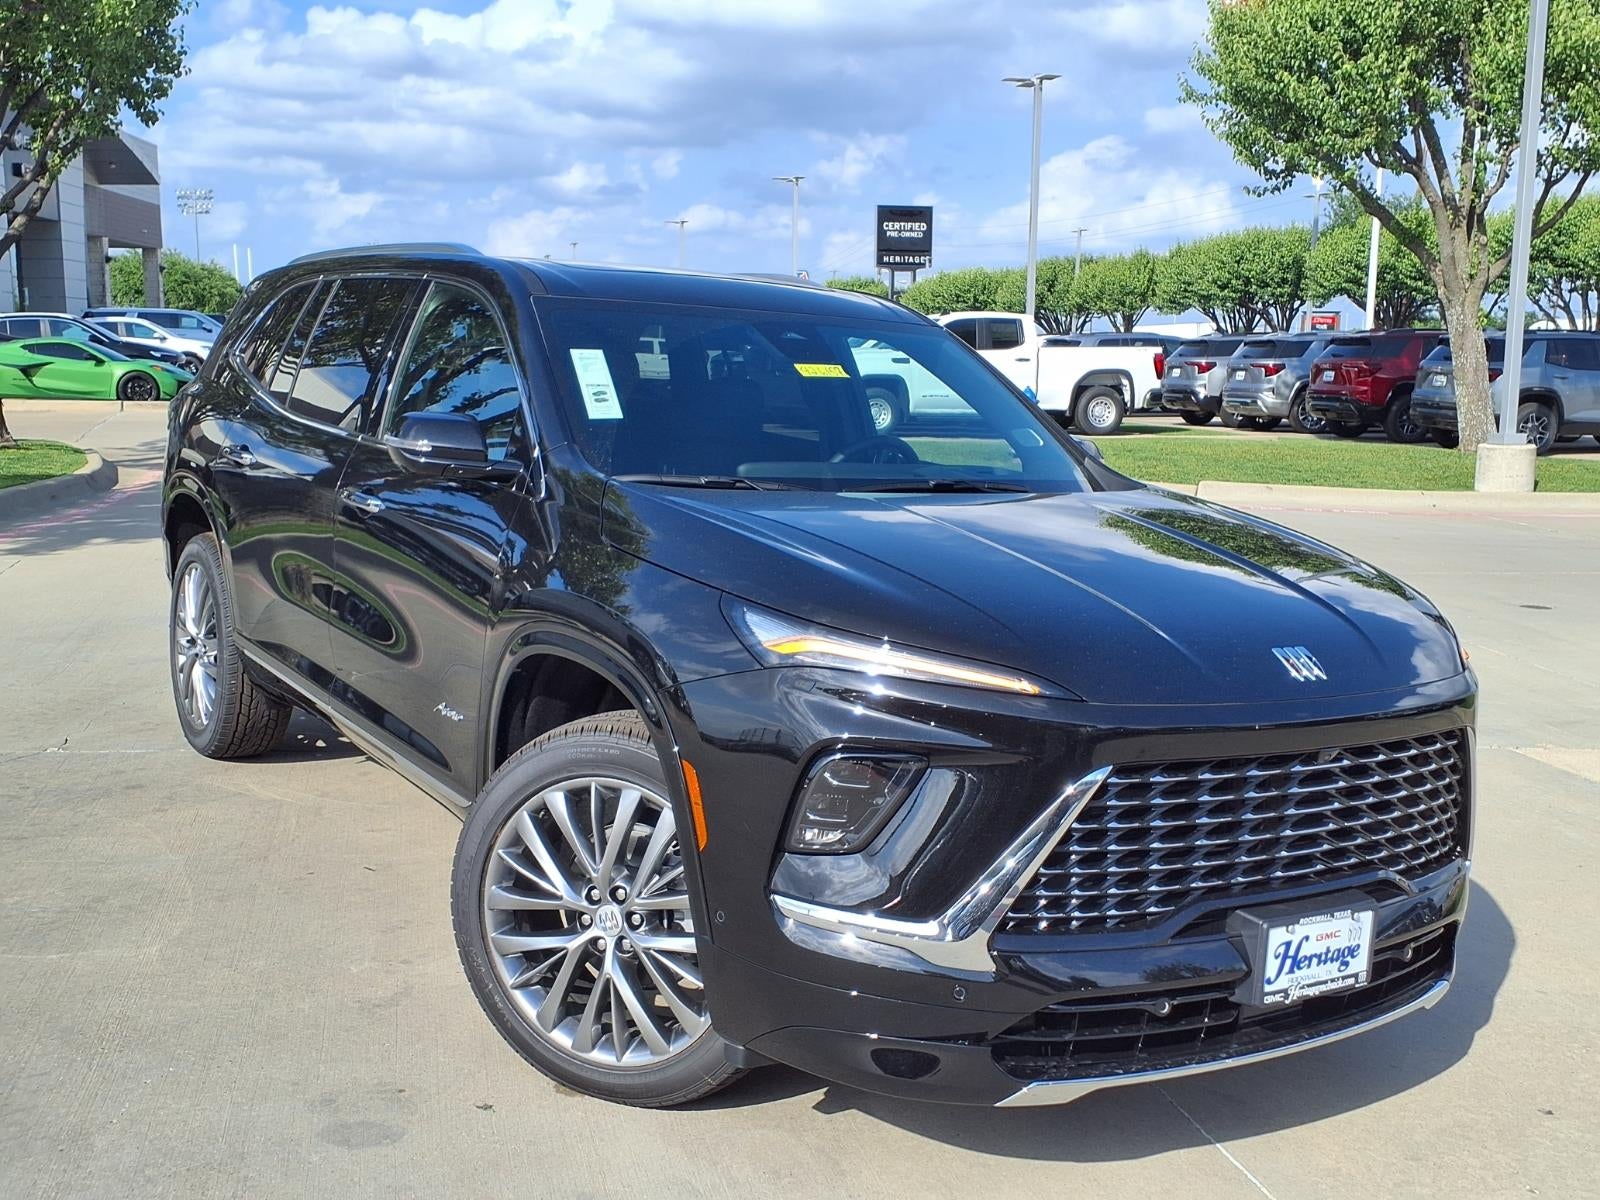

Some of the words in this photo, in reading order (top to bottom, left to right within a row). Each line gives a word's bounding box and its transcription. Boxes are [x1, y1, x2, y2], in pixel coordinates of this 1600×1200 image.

[883, 222, 927, 231] CERTIFIED
[1333, 910, 1352, 920] TEXAS
[1316, 930, 1341, 941] GMC
[1265, 935, 1360, 985] Heritage
[1264, 994, 1285, 1004] GMC
